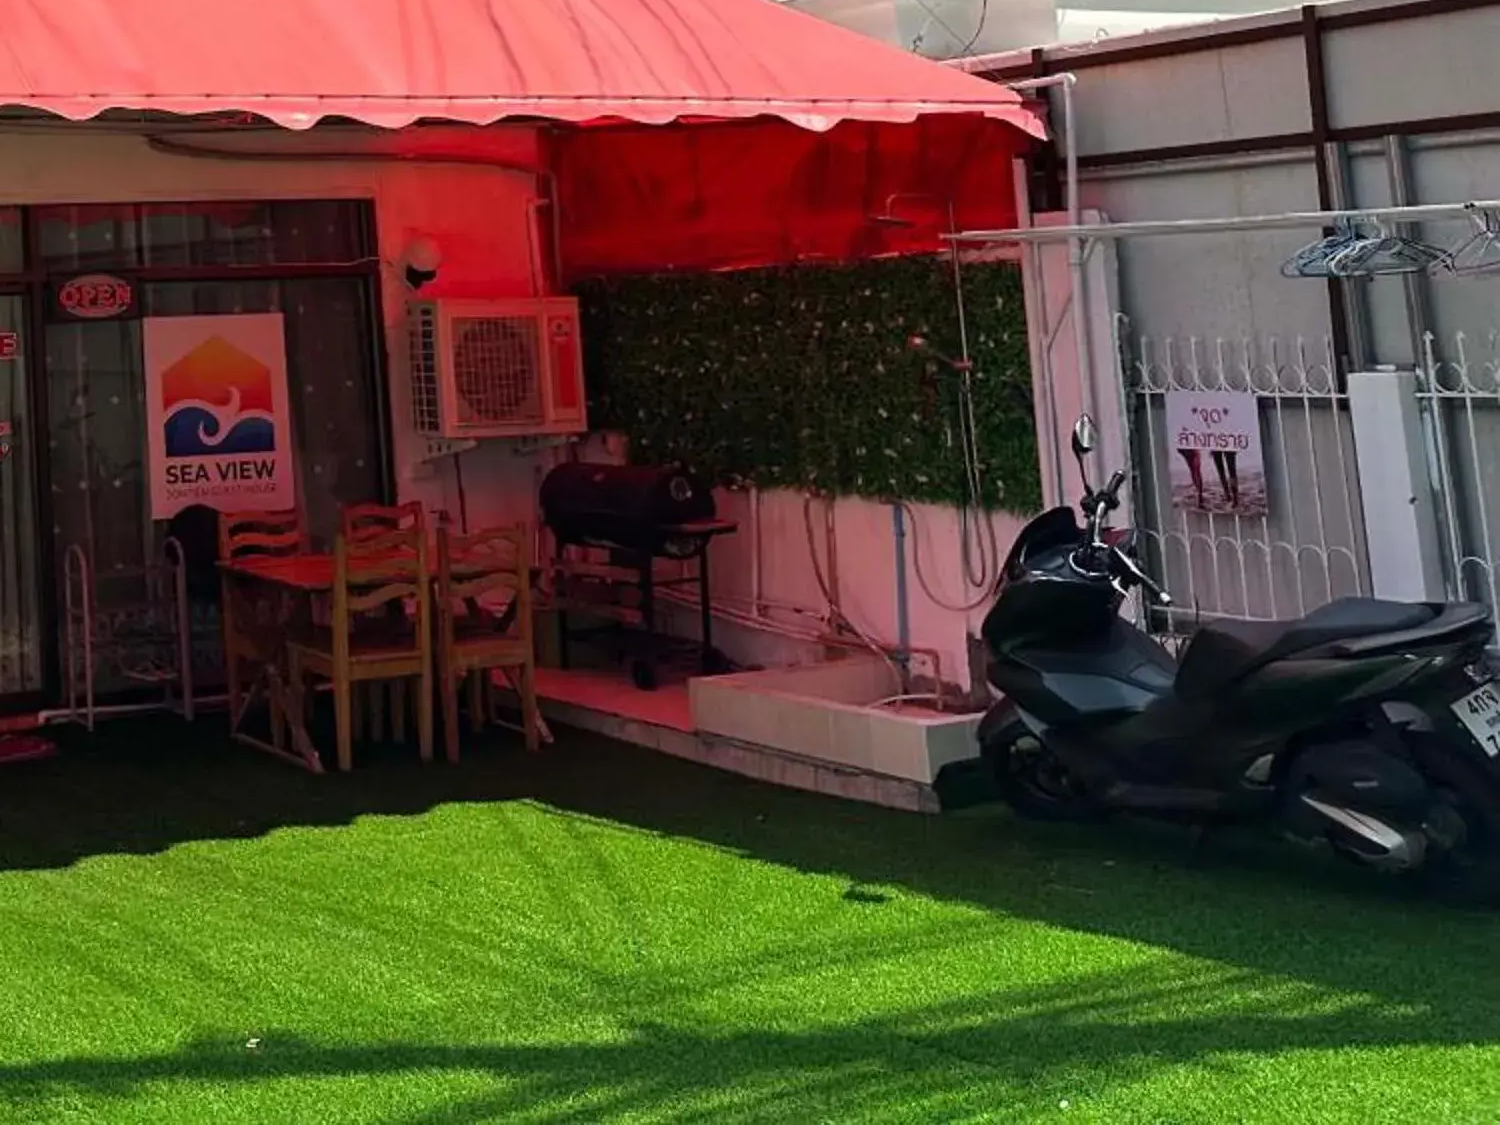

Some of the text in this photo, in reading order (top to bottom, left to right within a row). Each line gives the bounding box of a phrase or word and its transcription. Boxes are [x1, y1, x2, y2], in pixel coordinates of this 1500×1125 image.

[60, 283, 131, 309] OPEN
[1179, 426, 1249, 450] ล้างทราย
[165, 459, 276, 484] SEA VIEW
